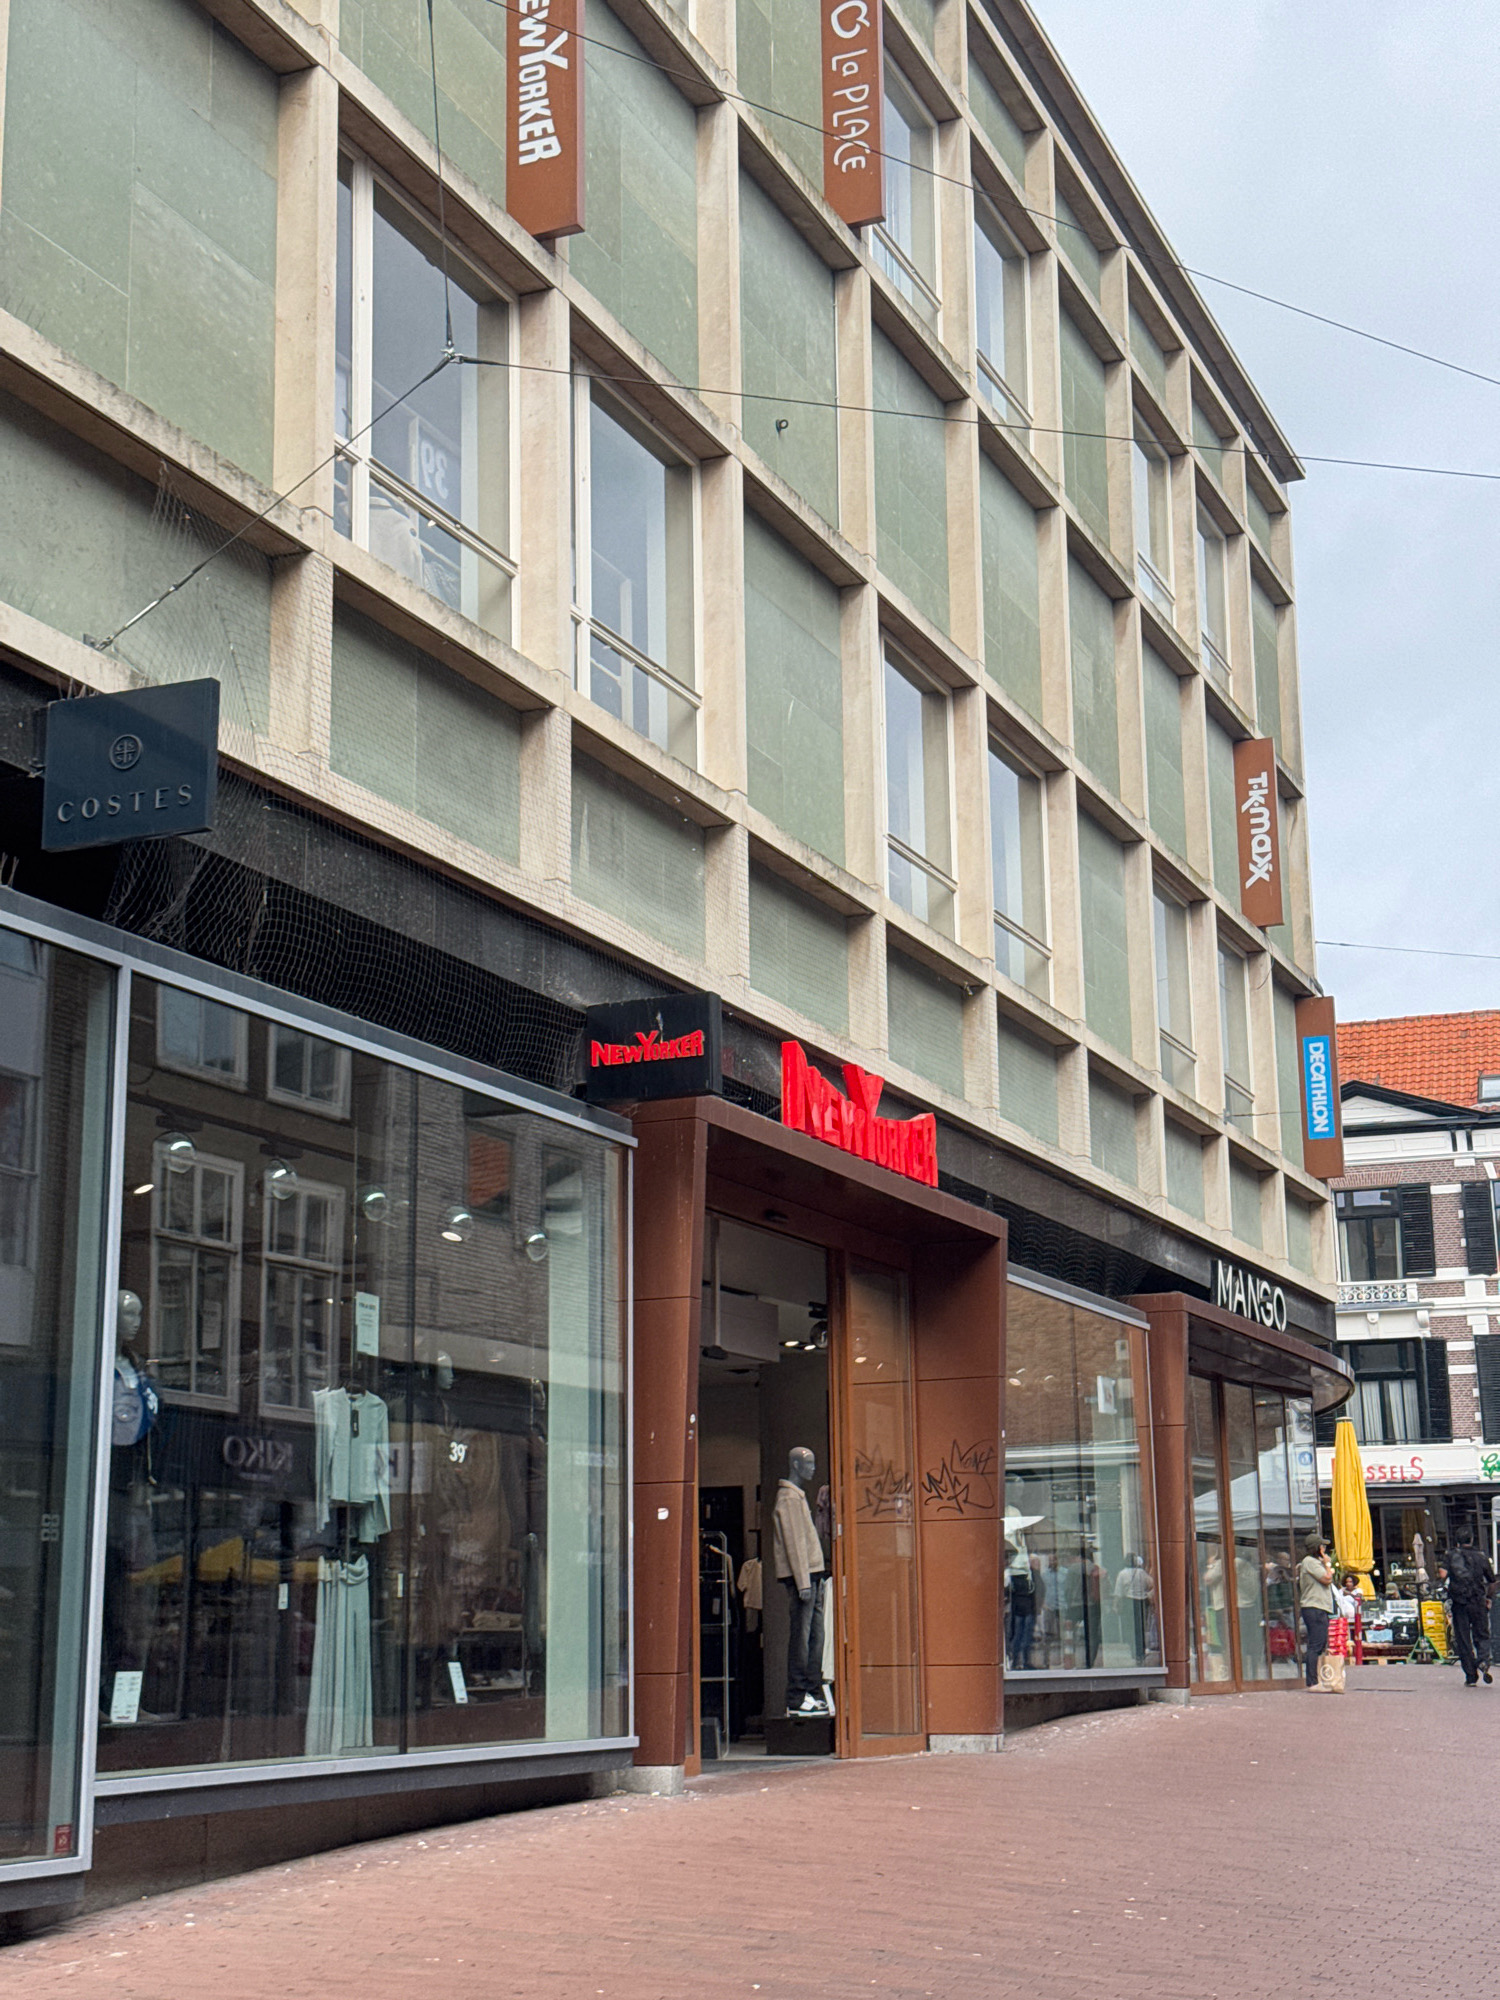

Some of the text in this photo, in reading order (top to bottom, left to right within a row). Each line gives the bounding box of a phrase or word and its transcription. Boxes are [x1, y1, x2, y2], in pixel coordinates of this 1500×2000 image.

[518, 0, 569, 165] EWYORKER
[57, 784, 193, 822] COSTES
[1308, 1042, 1330, 1132] DECATHLON
[1217, 1259, 1287, 1333] MANGO
